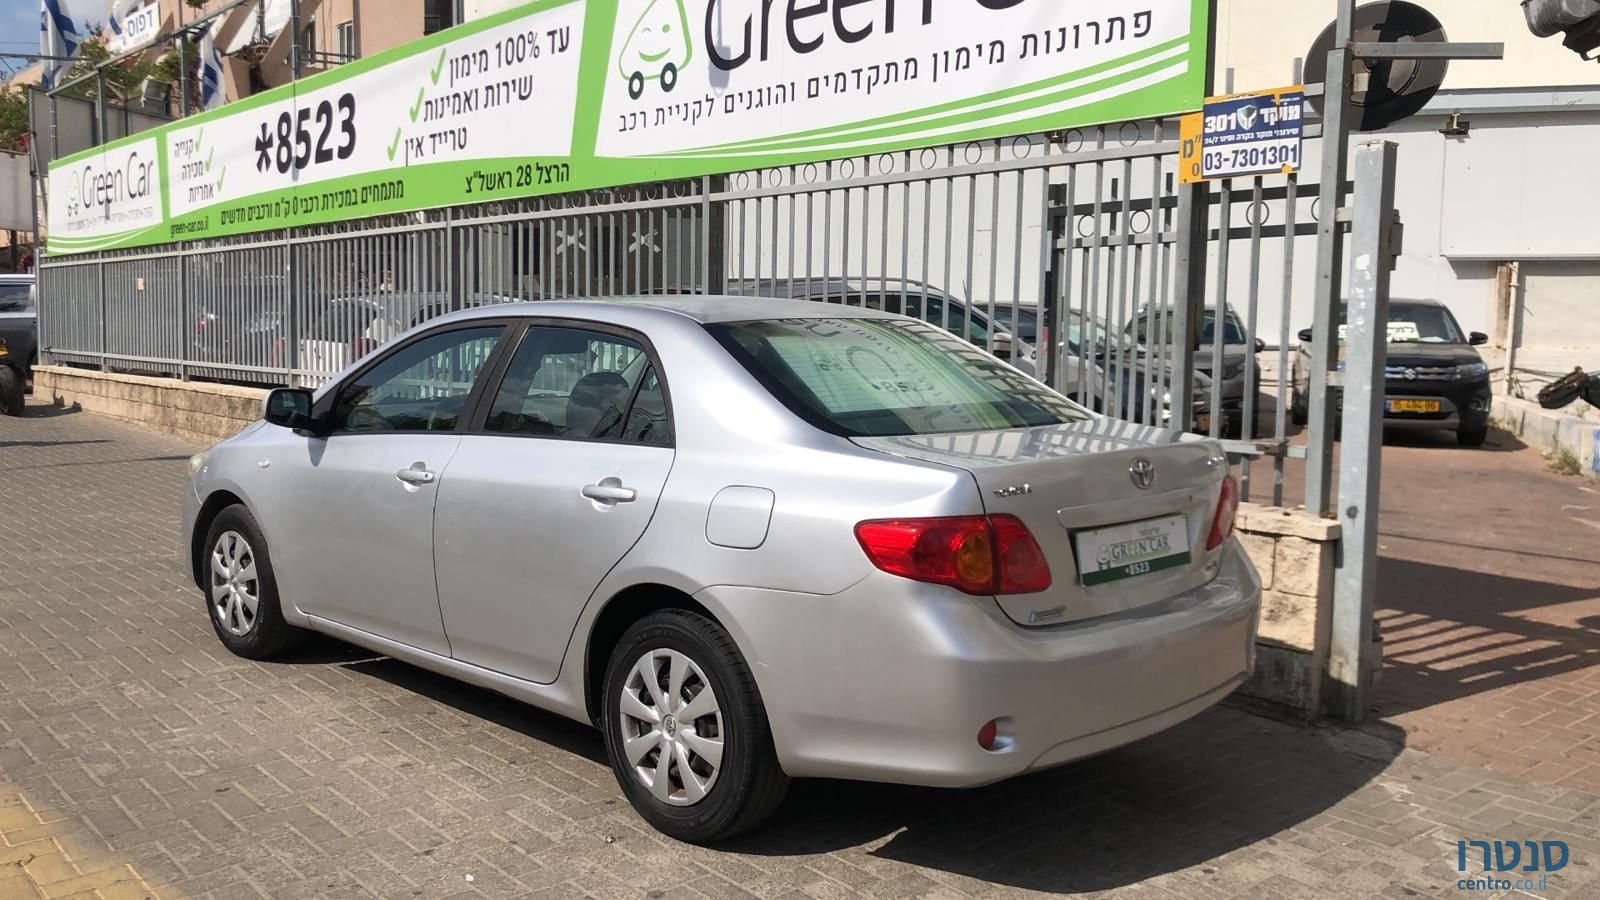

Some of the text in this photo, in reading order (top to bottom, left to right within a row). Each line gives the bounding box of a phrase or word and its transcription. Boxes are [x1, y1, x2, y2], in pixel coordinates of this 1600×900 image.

[127, 9, 153, 37] דפוס
[449, 26, 570, 88] עד 100% מימון
[618, 10, 1152, 132] פתרונות מימון מתקדמים והוגנים לקניית רכב
[423, 75, 533, 122] שירות ואמינות
[1204, 112, 1236, 133] 301
[174, 138, 193, 159] קנייה
[405, 127, 467, 167] טרייד אין
[1204, 143, 1298, 171] 03-7301301
[82, 151, 154, 208] Green Car
[181, 160, 204, 180] מכירה
[516, 165, 533, 187] 28
[536, 162, 570, 184] הרצל
[189, 183, 214, 204] אחריות
[322, 189, 358, 212] במכירת
[361, 180, 404, 204] מתמחים
[221, 206, 246, 225] חדשים
[247, 201, 272, 222] ורכבים
[300, 195, 319, 214] רכבי
[1111, 535, 1171, 560] GREEN CAR
